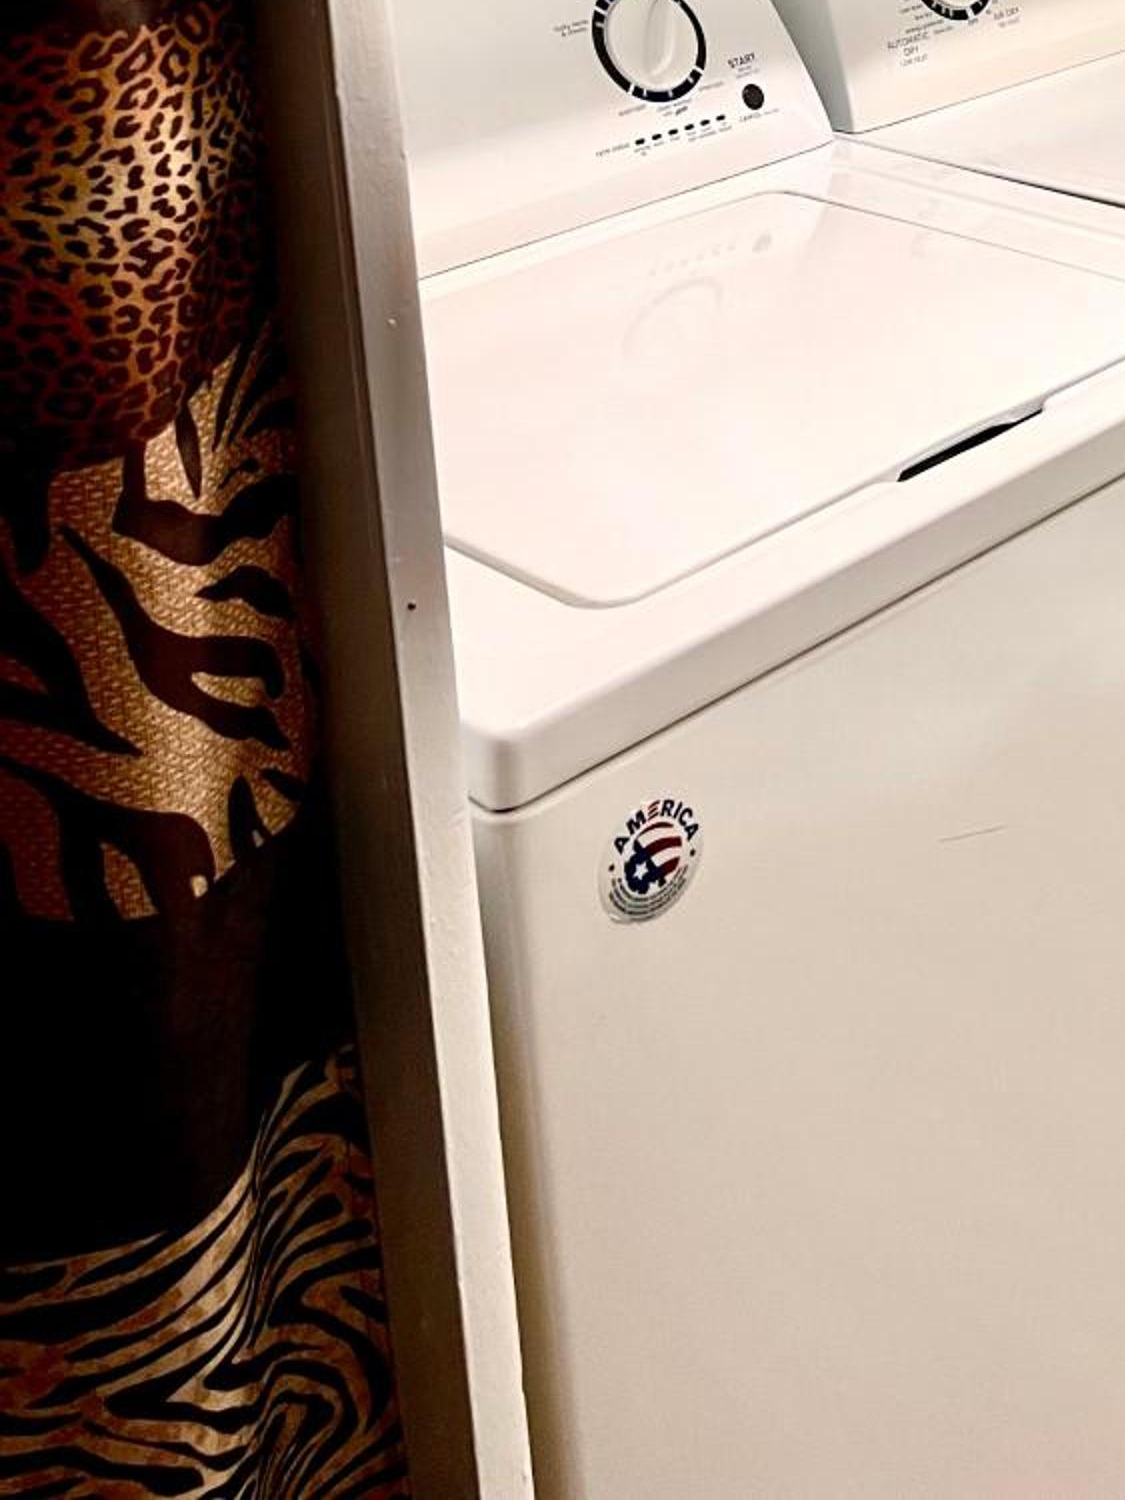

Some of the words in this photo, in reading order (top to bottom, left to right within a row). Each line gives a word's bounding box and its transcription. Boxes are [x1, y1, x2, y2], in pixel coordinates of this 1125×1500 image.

[888, 31, 930, 49] AUTOMATIC
[728, 52, 756, 69] START
[614, 799, 699, 855] AMERICA
